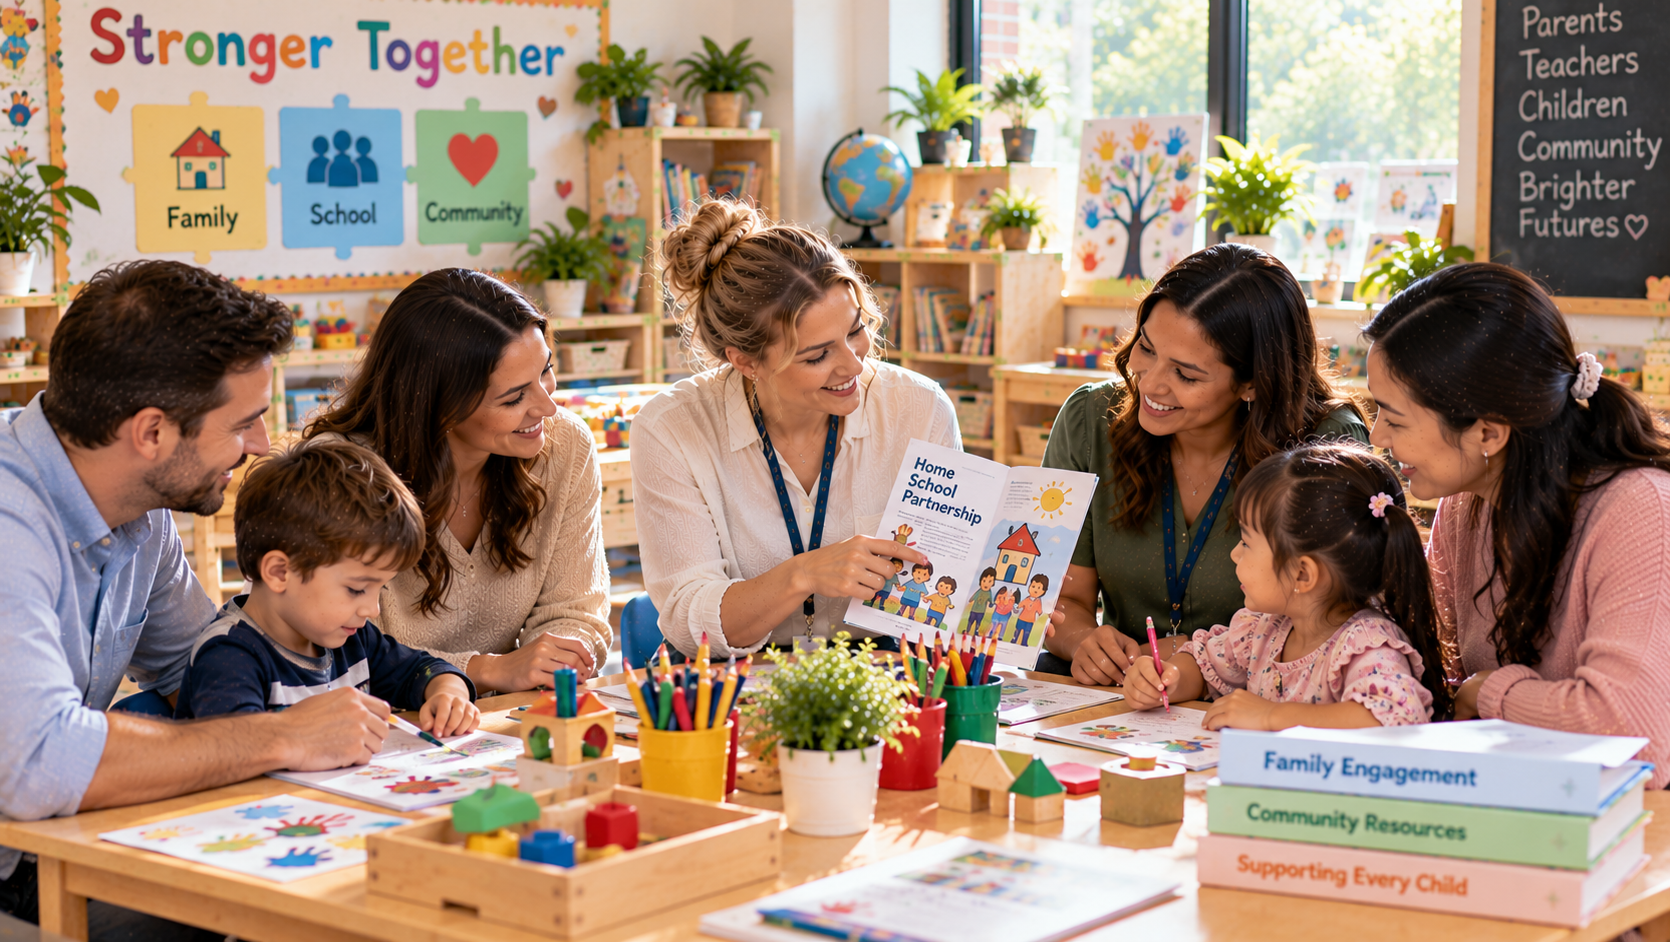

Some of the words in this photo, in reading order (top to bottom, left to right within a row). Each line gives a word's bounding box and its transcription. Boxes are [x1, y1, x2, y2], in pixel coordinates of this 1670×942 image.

[1522, 2, 1623, 39] Parents
[90, 7, 333, 84] Stronger
[357, 20, 565, 88] Together
[1519, 44, 1639, 80] Teachers
[1518, 87, 1628, 122] Children
[1517, 128, 1662, 170] Community
[1519, 169, 1636, 211] Brighter
[167, 204, 239, 234] Family
[310, 202, 377, 226] School
[425, 201, 524, 226] Community
[1519, 207, 1620, 238] Futures
[907, 473, 958, 499] School
[914, 457, 956, 480] Home
[901, 489, 982, 527] Partnership
[1264, 751, 1335, 779] Family
[1341, 758, 1477, 786] Engagement
[1246, 802, 1360, 834] Community
[1364, 813, 1467, 840] Resources
[1237, 854, 1349, 888] Supporting
[1354, 866, 1411, 895] Every
[1415, 873, 1468, 897] Child
